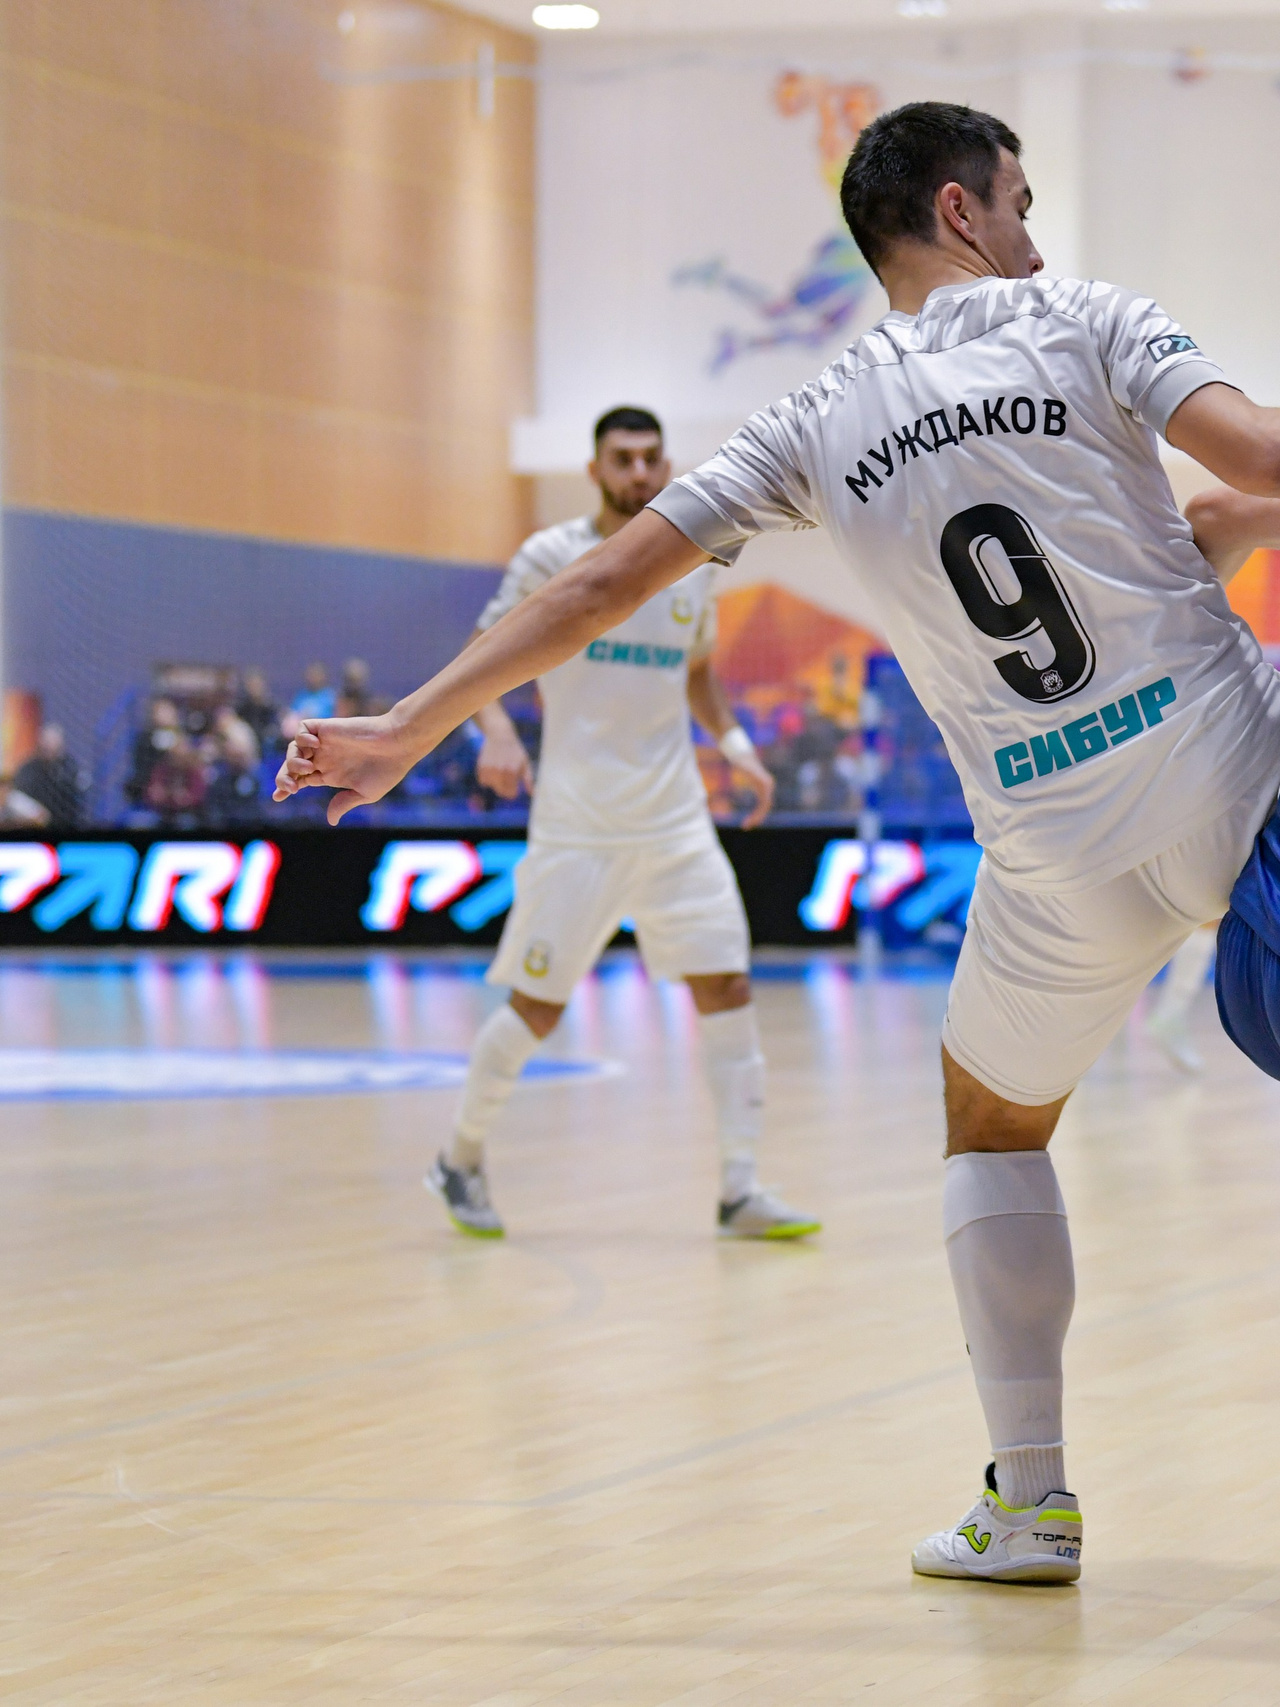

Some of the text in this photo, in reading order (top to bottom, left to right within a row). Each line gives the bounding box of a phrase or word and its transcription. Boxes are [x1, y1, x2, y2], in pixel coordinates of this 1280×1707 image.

[845, 396, 1067, 504] МУЖДАКОВ
[940, 503, 1096, 704] 9
[994, 677, 1178, 789] СИБУР
